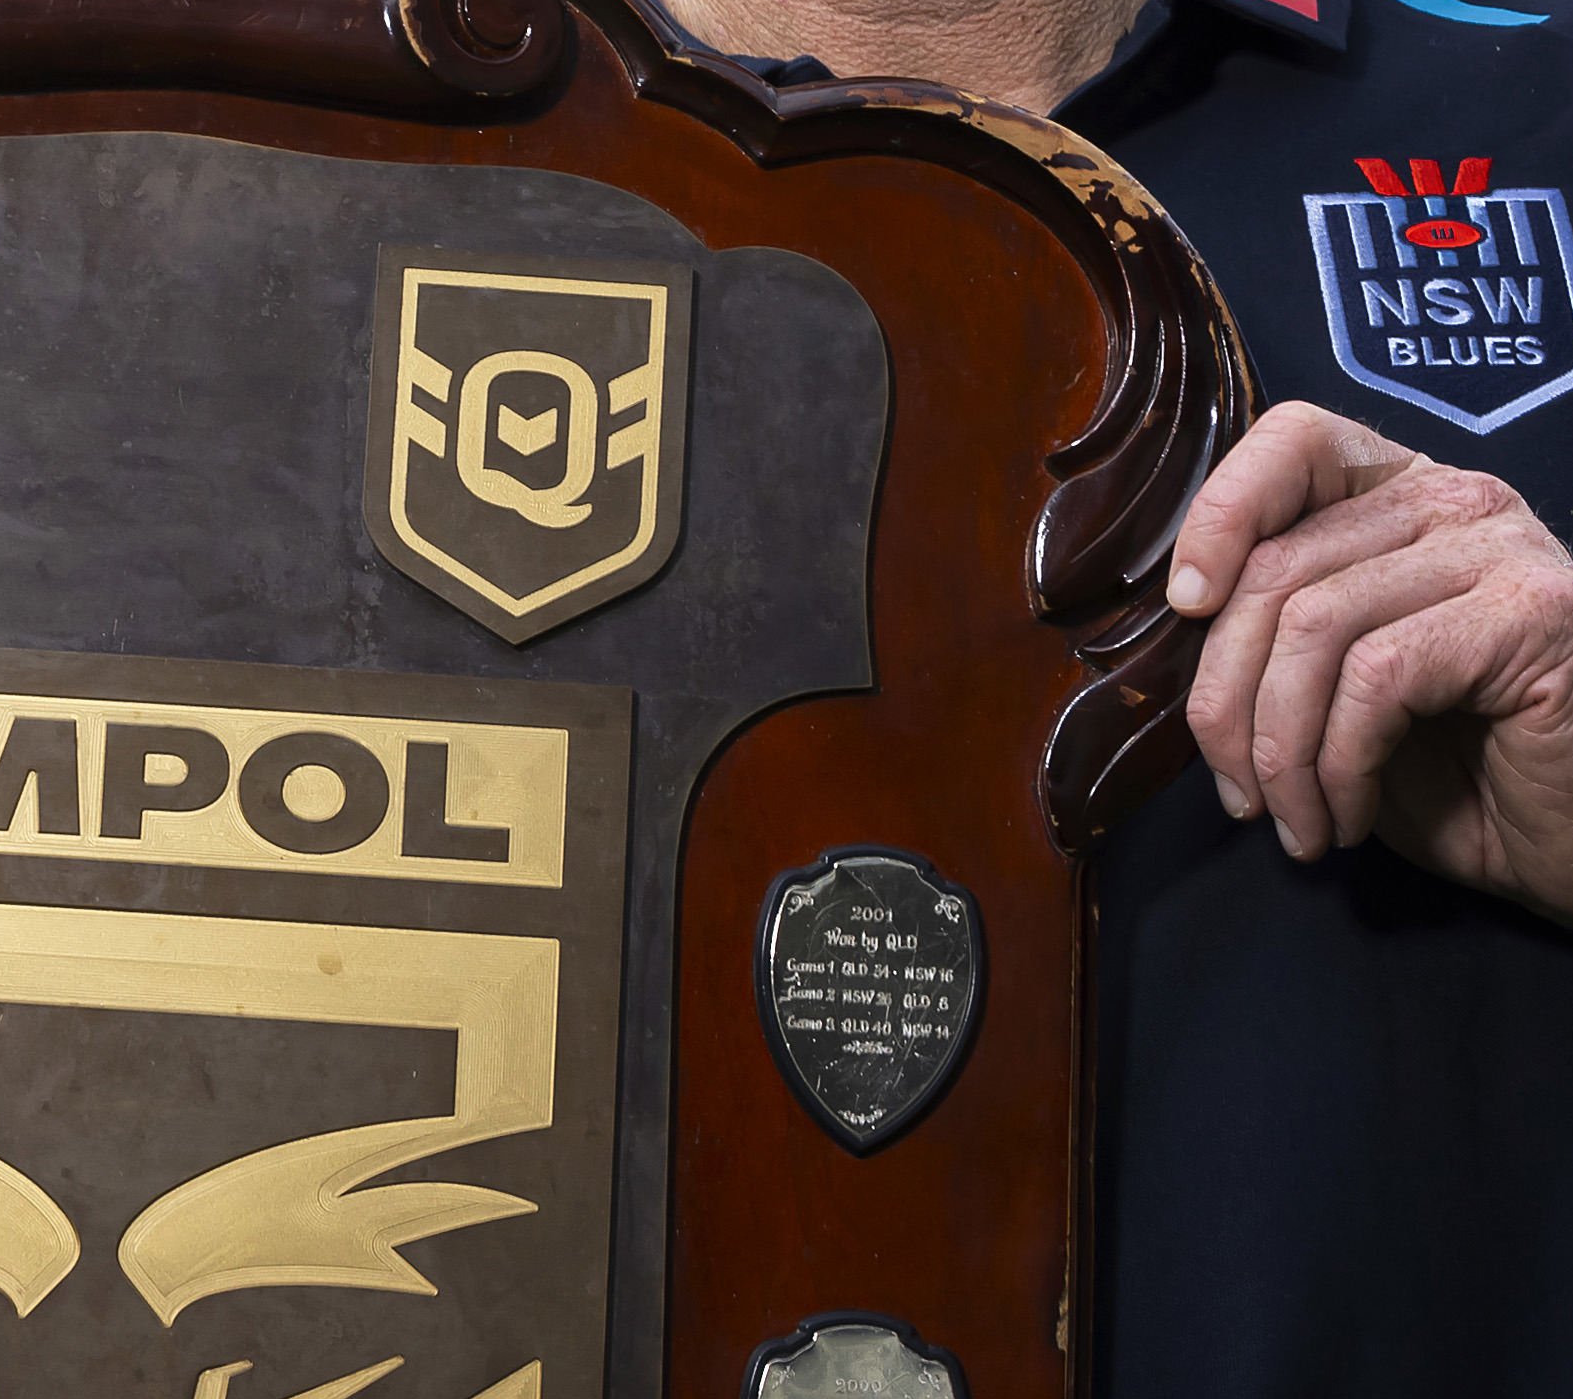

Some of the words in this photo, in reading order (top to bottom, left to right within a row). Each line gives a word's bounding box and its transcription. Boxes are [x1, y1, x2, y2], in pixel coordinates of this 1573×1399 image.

[1360, 276, 1543, 328] NSW
[1387, 336, 1544, 366] BLUES
[456, 350, 599, 529] Q
[851, 906, 893, 923] 2001
[825, 927, 857, 945] Won
[862, 930, 878, 955] by
[885, 934, 918, 950] QLD
[841, 961, 868, 977] QLD
[904, 966, 936, 982] NSW
[842, 989, 875, 1004] NSW
